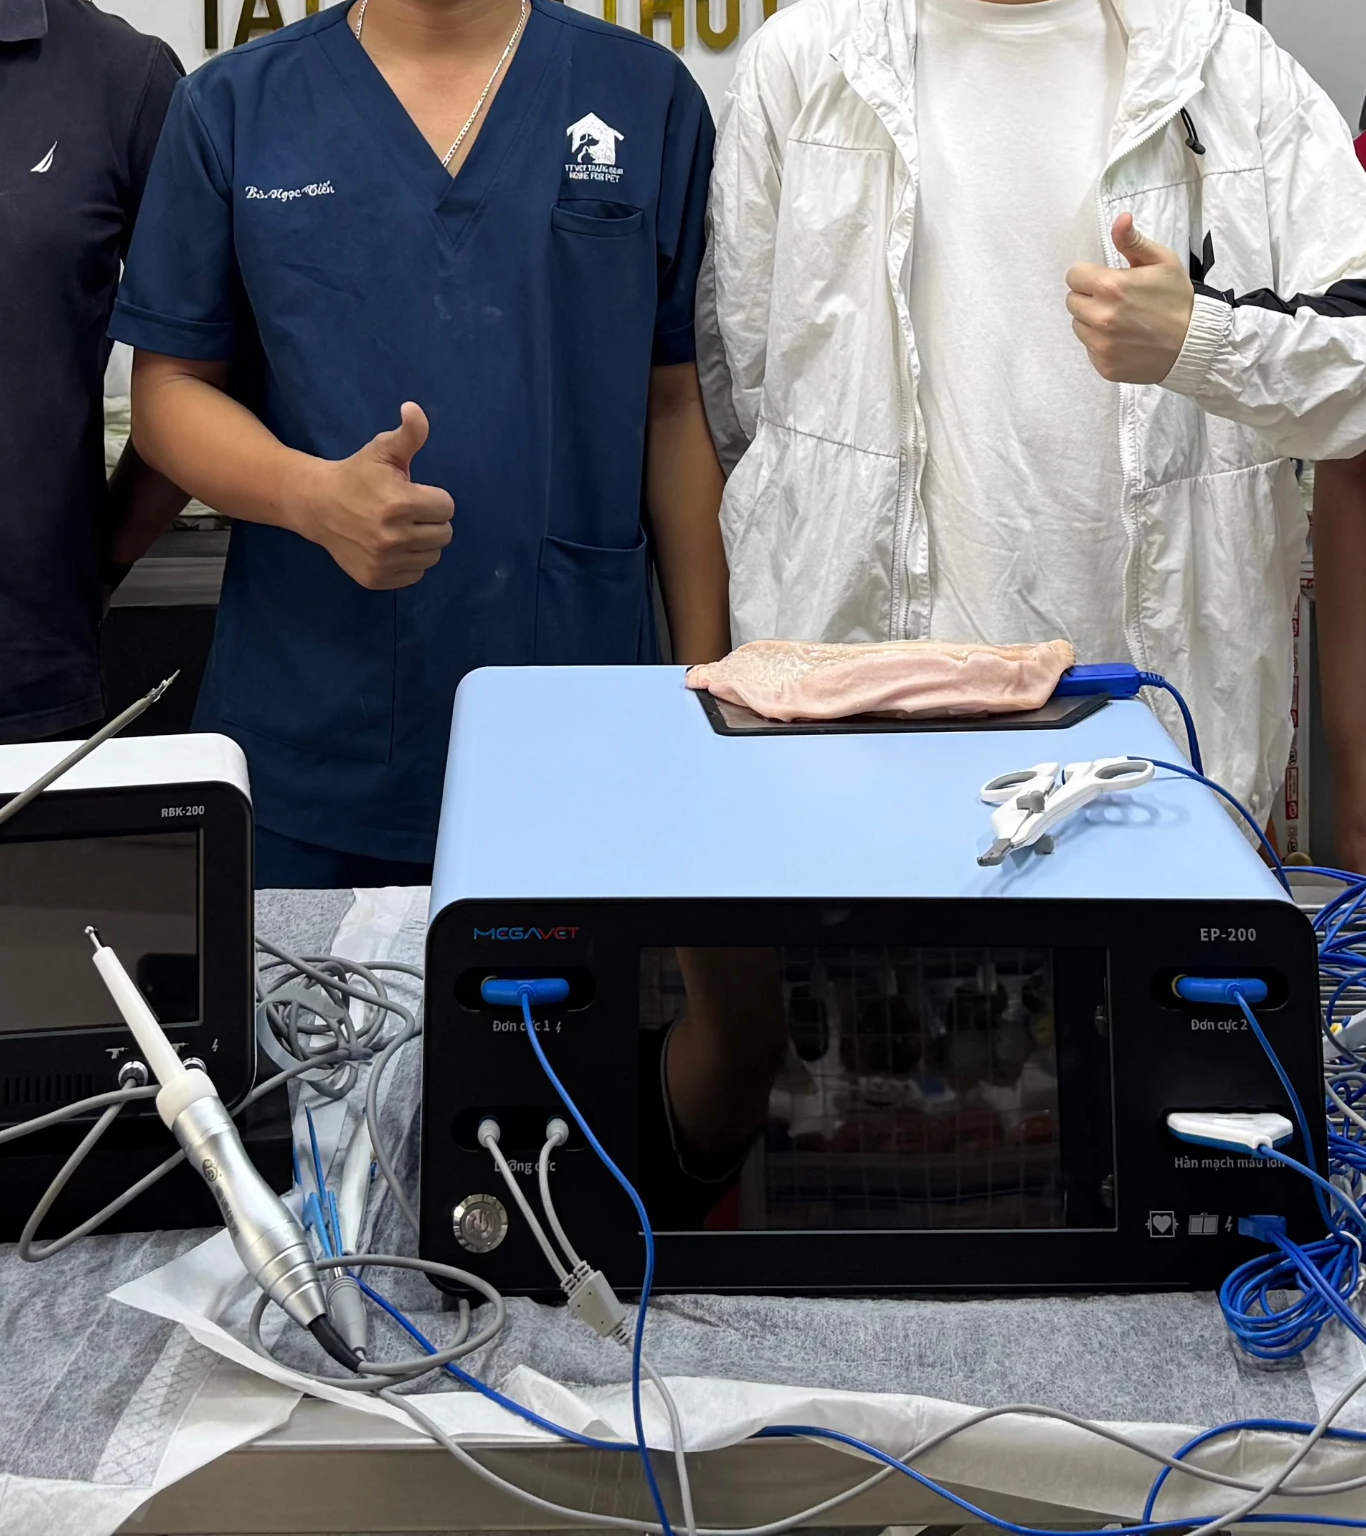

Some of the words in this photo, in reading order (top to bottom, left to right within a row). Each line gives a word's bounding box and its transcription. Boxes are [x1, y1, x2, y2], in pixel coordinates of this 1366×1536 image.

[605, 174, 620, 183] PET
[161, 805, 205, 818] RBK-200
[473, 927, 580, 940] MEGAVET
[1200, 928, 1257, 941] EP-200
[543, 1020, 550, 1032] 1
[1191, 1019, 1215, 1031] Đơn
[1218, 1019, 1238, 1033] cực
[1241, 1019, 1248, 1031] 2
[1175, 1155, 1199, 1169] Hàn
[1201, 1156, 1234, 1171] mạch
